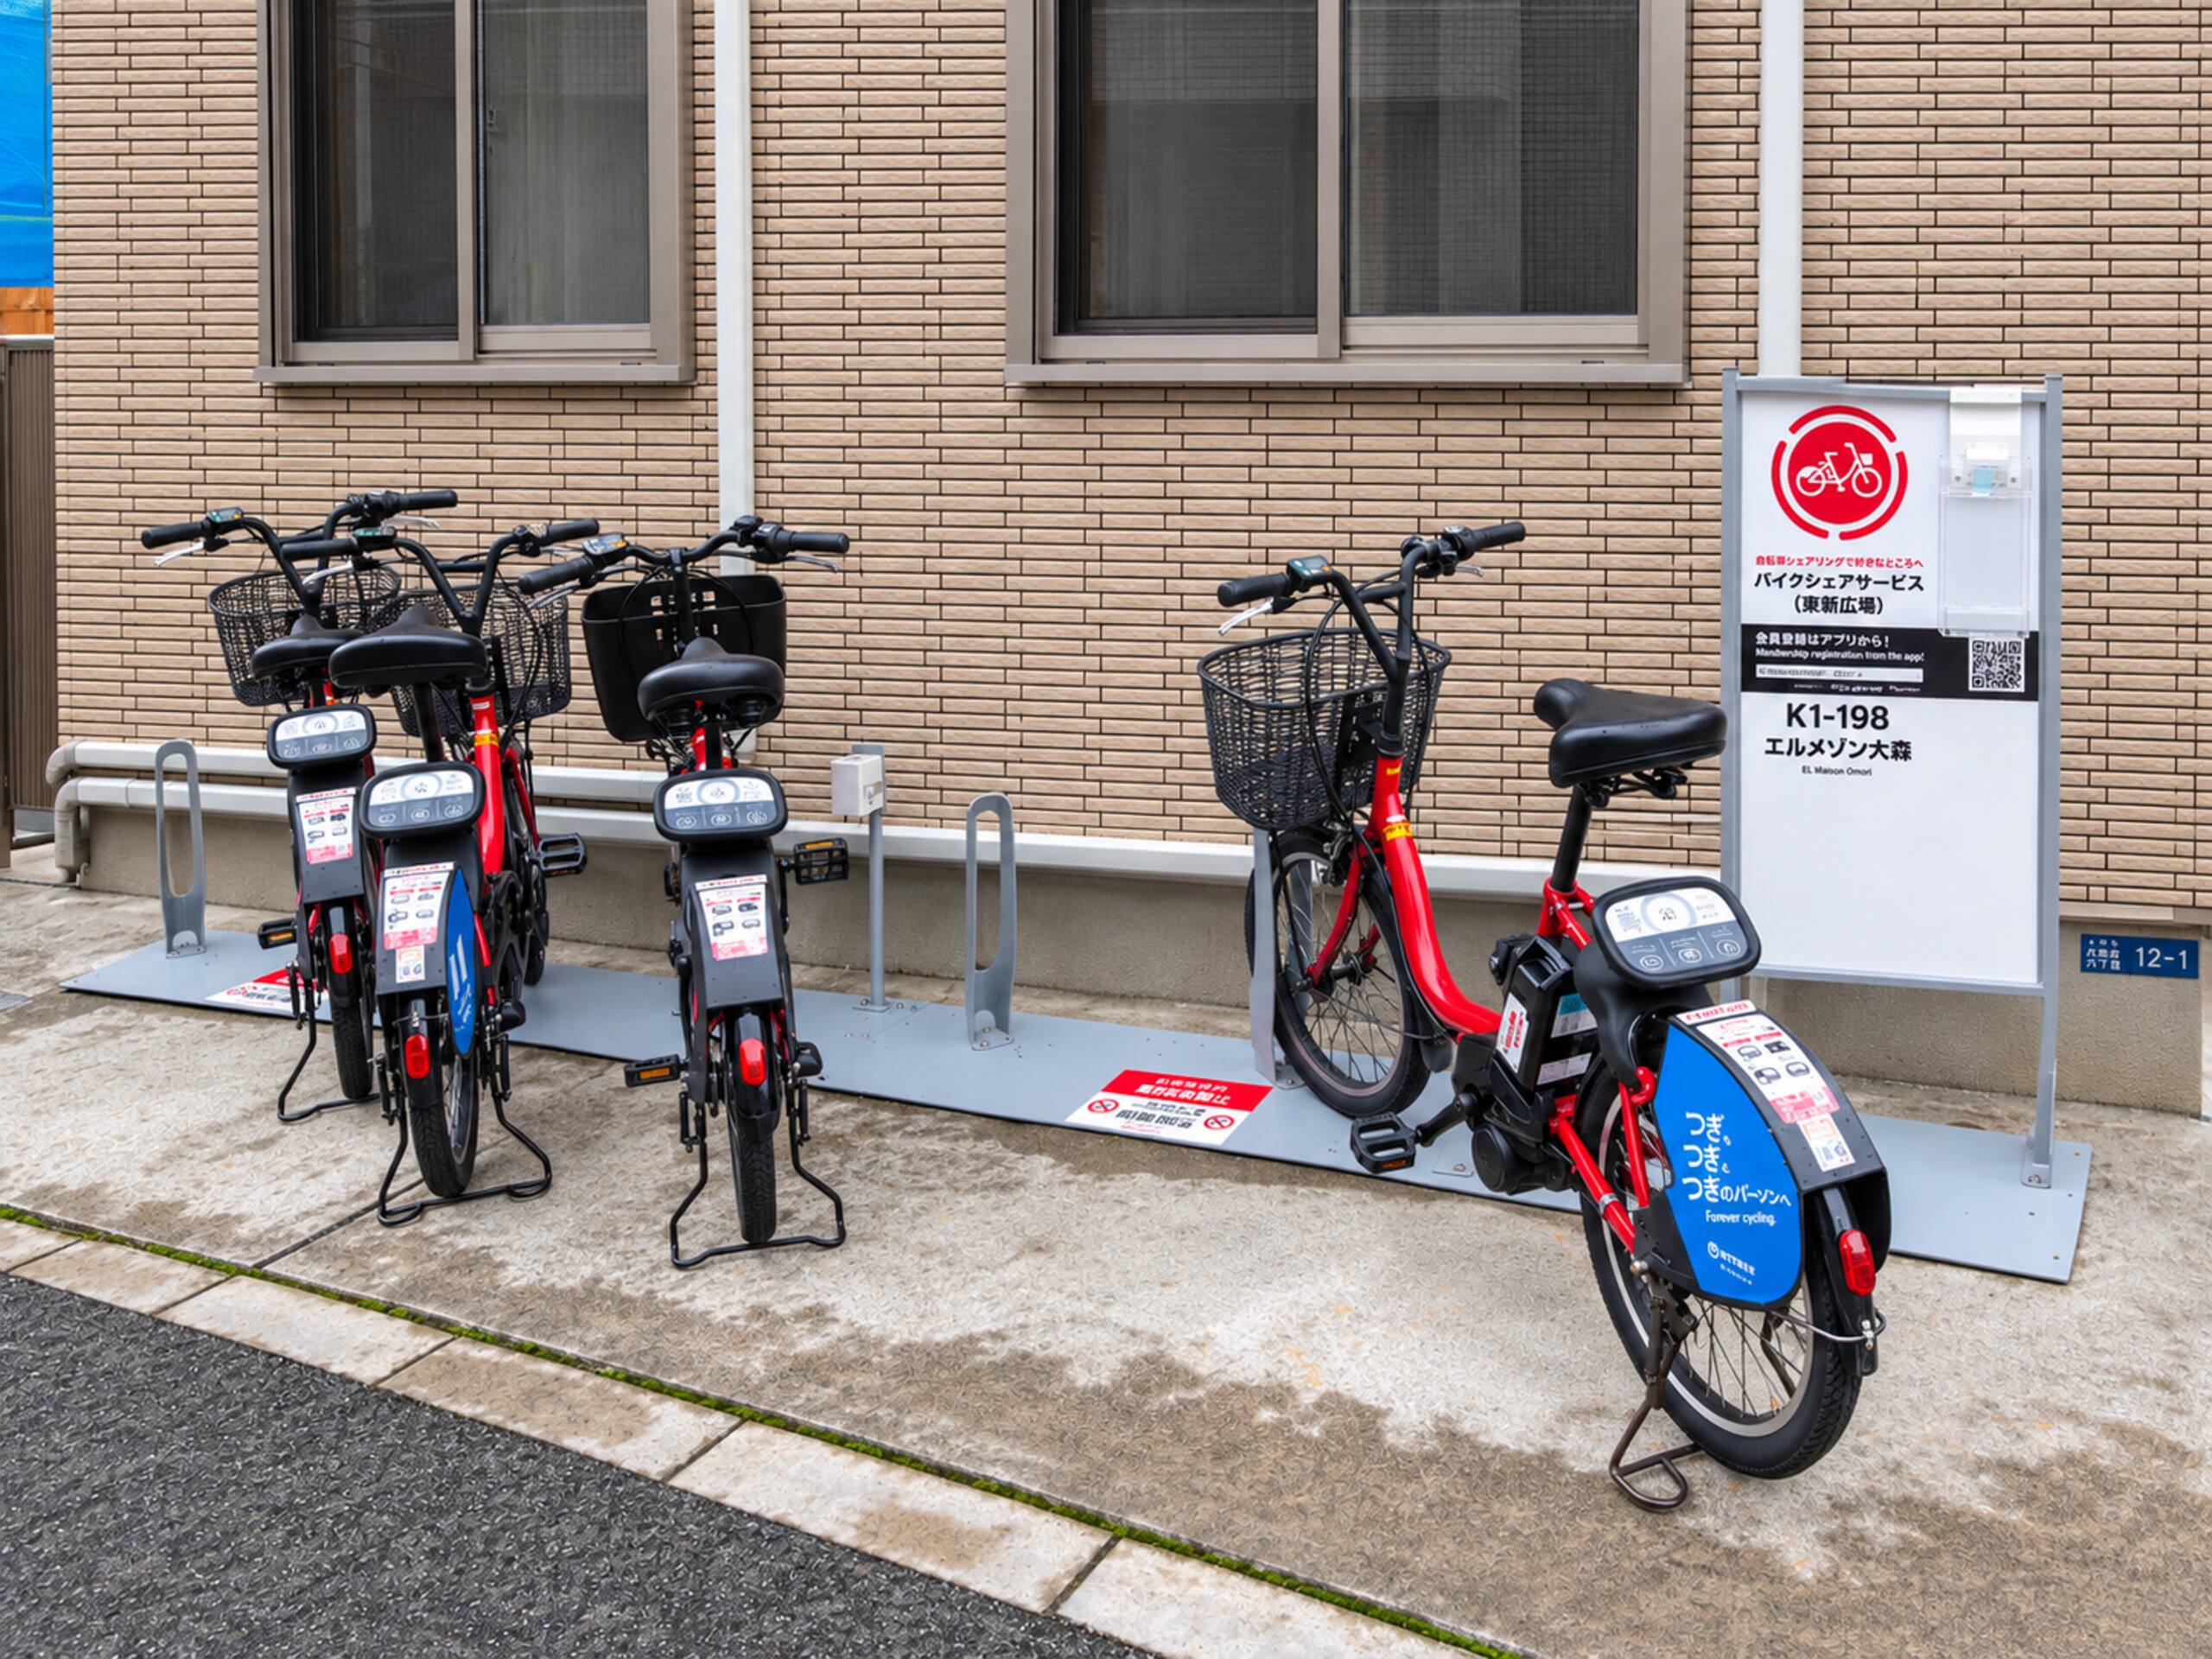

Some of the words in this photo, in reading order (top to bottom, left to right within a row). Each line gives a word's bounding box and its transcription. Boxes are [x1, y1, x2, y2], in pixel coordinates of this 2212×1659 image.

[1754, 572, 1924, 591] バイクシェアサービス
[1887, 652, 1902, 661] the
[1786, 702, 1890, 730] K1-198
[1764, 737, 1912, 762] エルメゾン大森
[1815, 766, 1844, 776] Maison
[1847, 766, 1872, 777] Omori
[2135, 946, 2188, 970] 12-1
[1706, 1210, 1740, 1224] Forever
